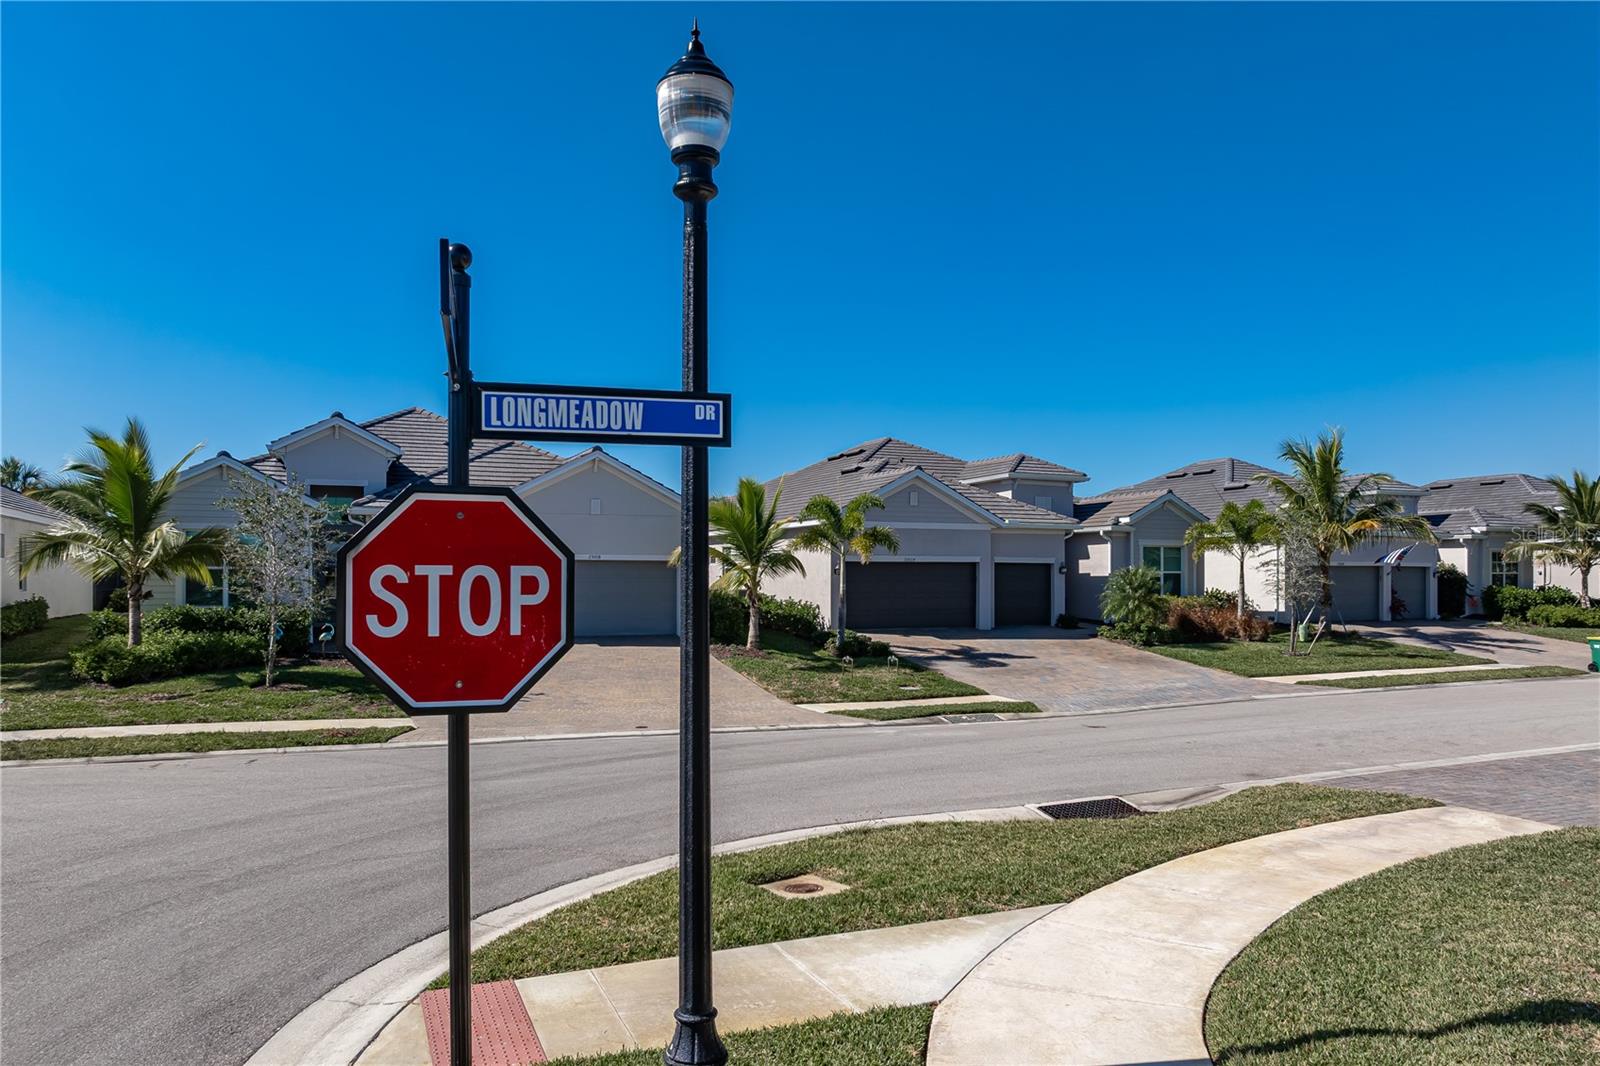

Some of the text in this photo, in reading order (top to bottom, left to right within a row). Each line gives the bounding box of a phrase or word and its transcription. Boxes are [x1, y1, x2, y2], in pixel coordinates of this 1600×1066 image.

[490, 396, 716, 430] LONGMEADOW DR
[365, 564, 550, 638] STOP
